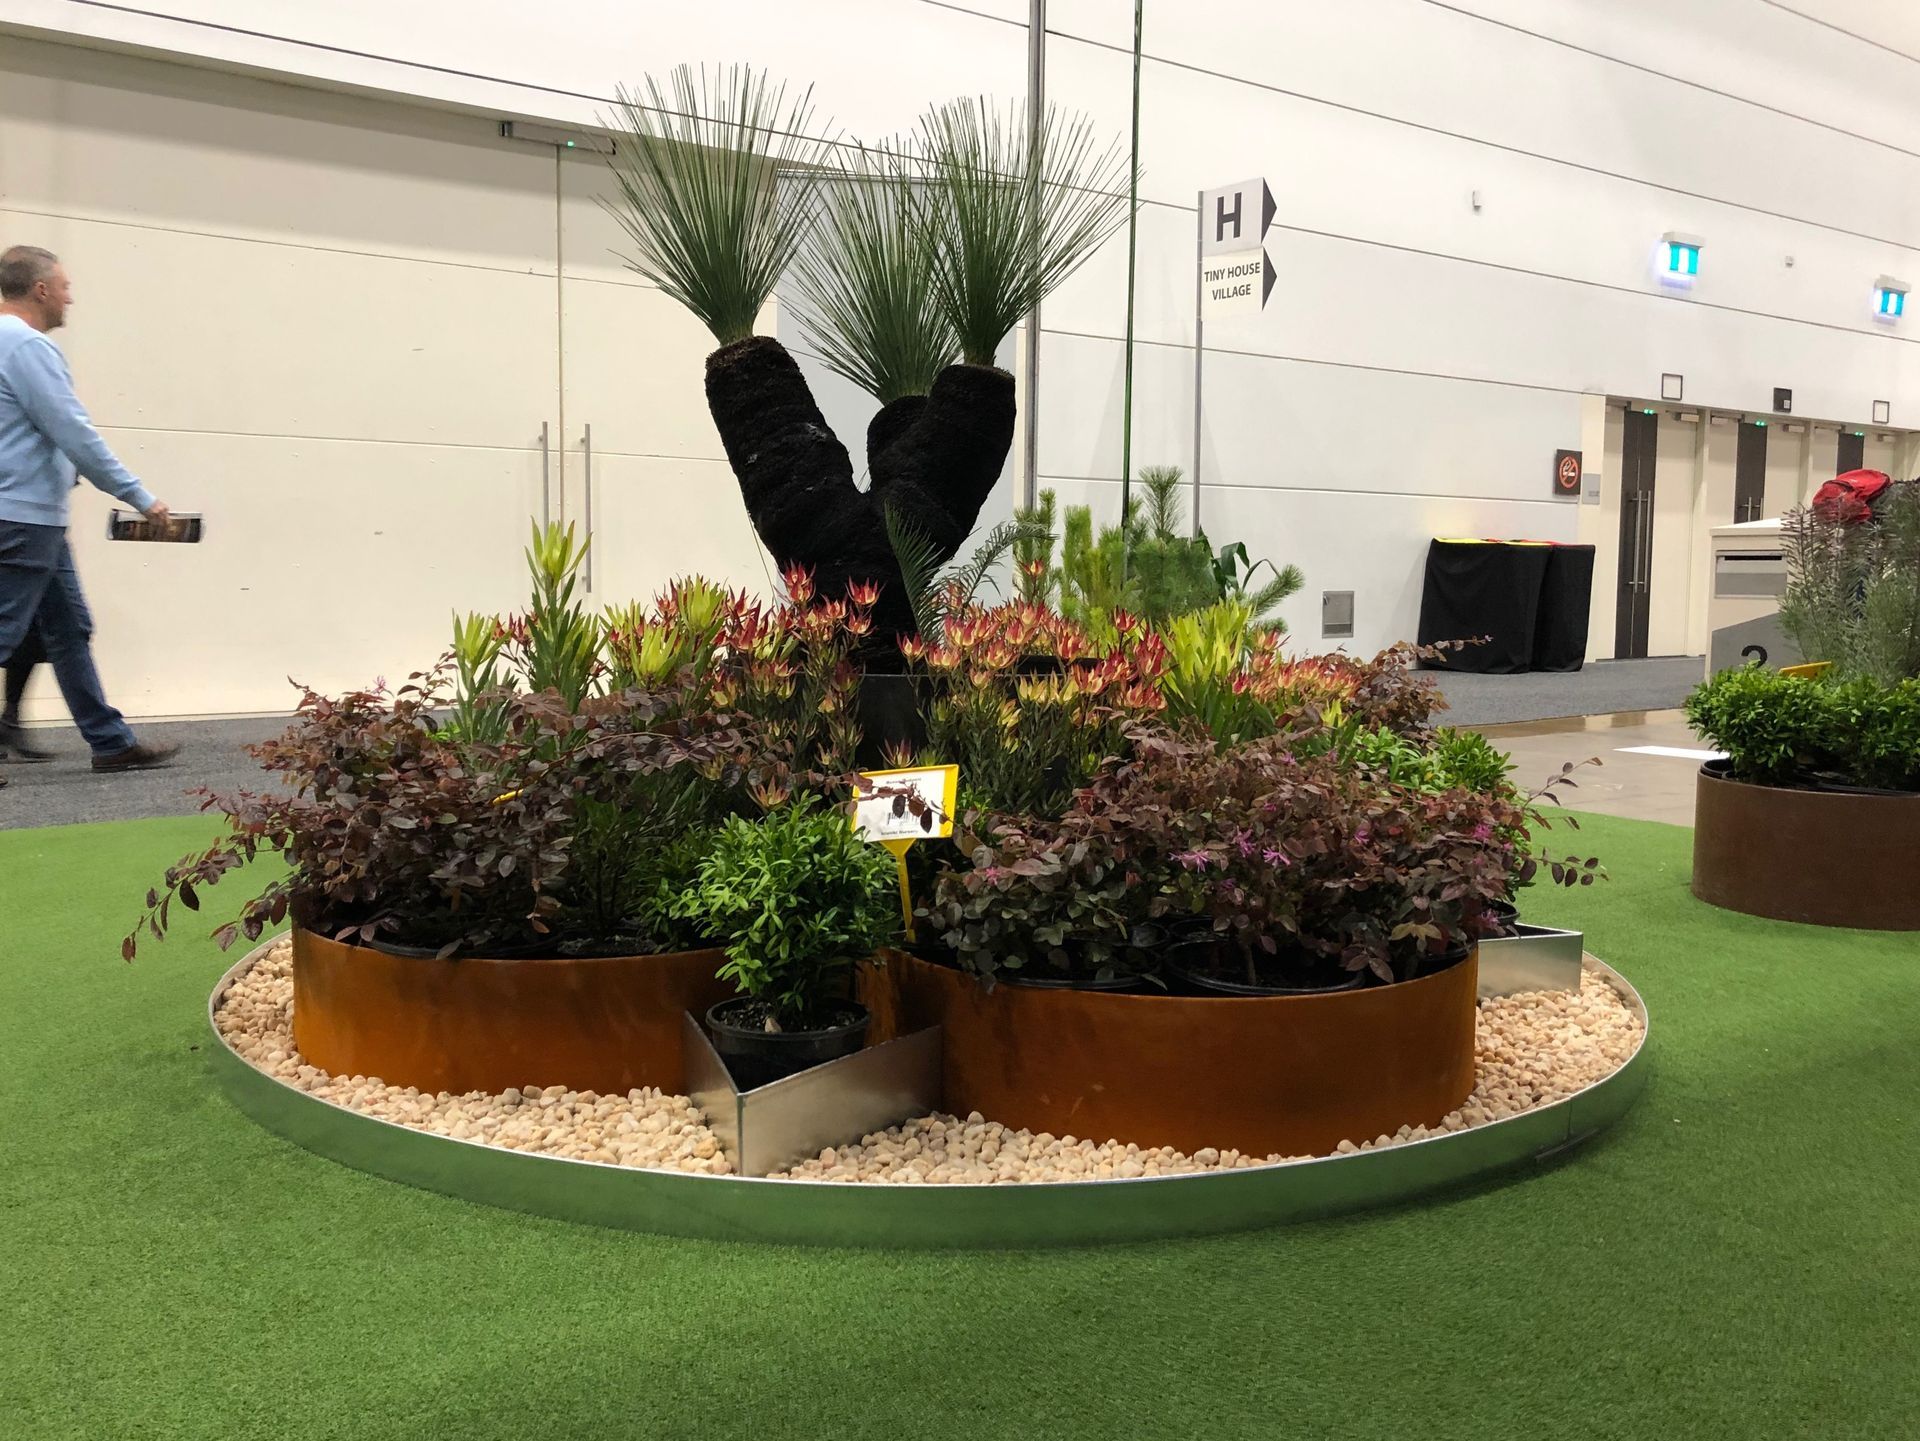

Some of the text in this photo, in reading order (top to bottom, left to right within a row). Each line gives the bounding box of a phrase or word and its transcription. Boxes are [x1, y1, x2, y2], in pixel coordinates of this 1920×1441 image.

[1216, 192, 1242, 242] H
[1204, 262, 1260, 283] TINY HOUSE
[1212, 284, 1251, 300] VILLAGE
